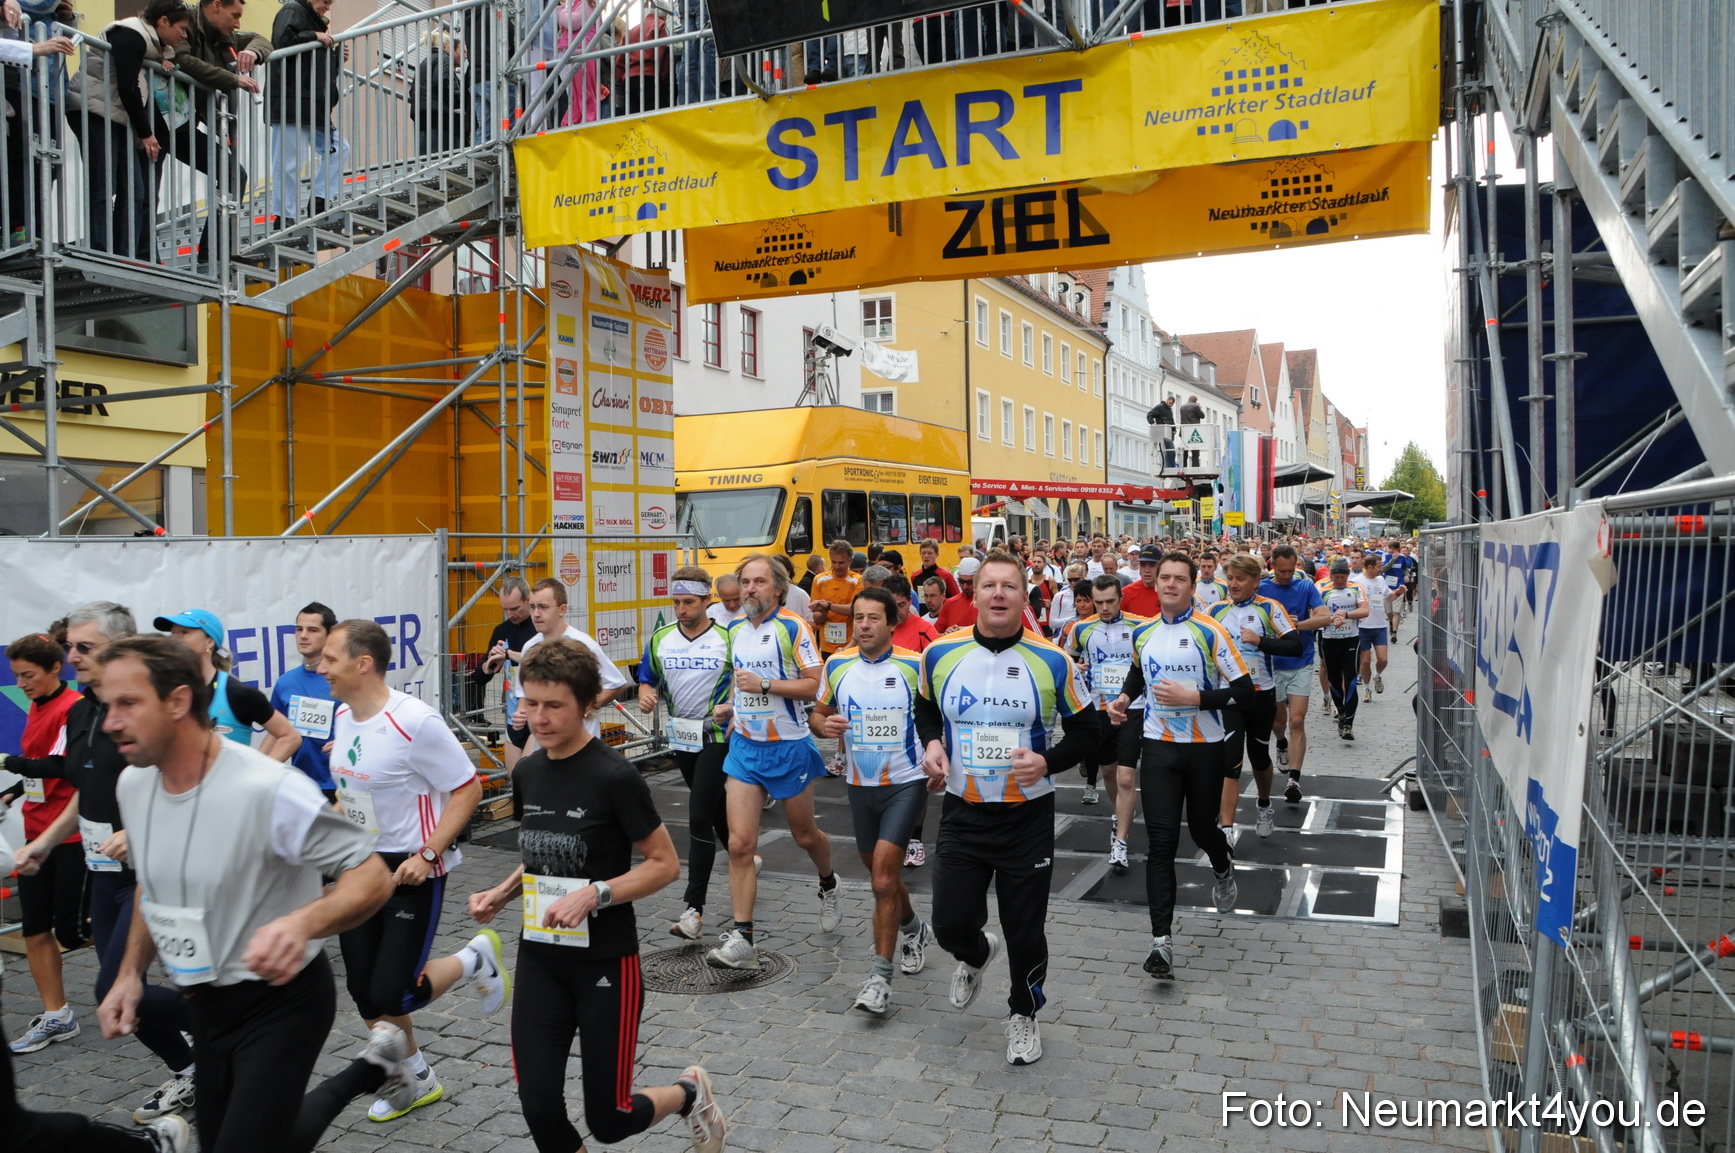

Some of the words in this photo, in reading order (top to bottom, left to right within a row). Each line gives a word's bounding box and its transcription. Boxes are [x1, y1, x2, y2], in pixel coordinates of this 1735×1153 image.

[1144, 97, 1269, 127] Neumarkter
[1274, 80, 1377, 111] Stadtlauf
[766, 78, 1083, 192] START
[553, 180, 639, 209] Neumarkter
[642, 171, 718, 194] Stadtlauf
[1208, 201, 1301, 222] Neumarkter
[1303, 187, 1390, 213] Stadtlauf
[942, 187, 1111, 259] ZIEL
[714, 255, 790, 272] Neumarkter
[792, 246, 857, 265] Stadtlauf
[630, 283, 672, 303] MERZ
[558, 334, 574, 344] KANN
[551, 402, 581, 418] Sinupret
[639, 396, 674, 417] OBI
[551, 417, 570, 430] forte
[592, 450, 618, 465] swn
[640, 451, 665, 466] MCM
[844, 467, 875, 478] SPORTRONIC
[708, 473, 763, 486] TIMING
[918, 475, 932, 485] EVENT
[932, 476, 948, 487] SERVICE
[982, 482, 1007, 490] Service
[1044, 485, 1080, 493] Serviceline:
[1080, 486, 1098, 494] 09181
[553, 521, 585, 530] HACKNER
[619, 517, 633, 526] BÖGL
[597, 561, 632, 577] Sinupret
[598, 579, 618, 592] forte
[830, 630, 843, 638] 113
[664, 656, 721, 670] BOCK
[746, 660, 774, 669] PLAST
[1164, 664, 1198, 672] PLAST
[1104, 675, 1126, 685] 3221
[301, 700, 319, 710] Daniel
[743, 696, 769, 707] 3219
[983, 696, 1028, 710] PLAST
[300, 711, 327, 725] 3229
[865, 713, 888, 722] Hubert
[954, 720, 1026, 728] www.tr-plast.de
[676, 730, 698, 741] 3099
[866, 725, 898, 737] 3228
[976, 732, 999, 742] Tobias
[977, 746, 1013, 760] 3225
[538, 881, 568, 898] Claudia
